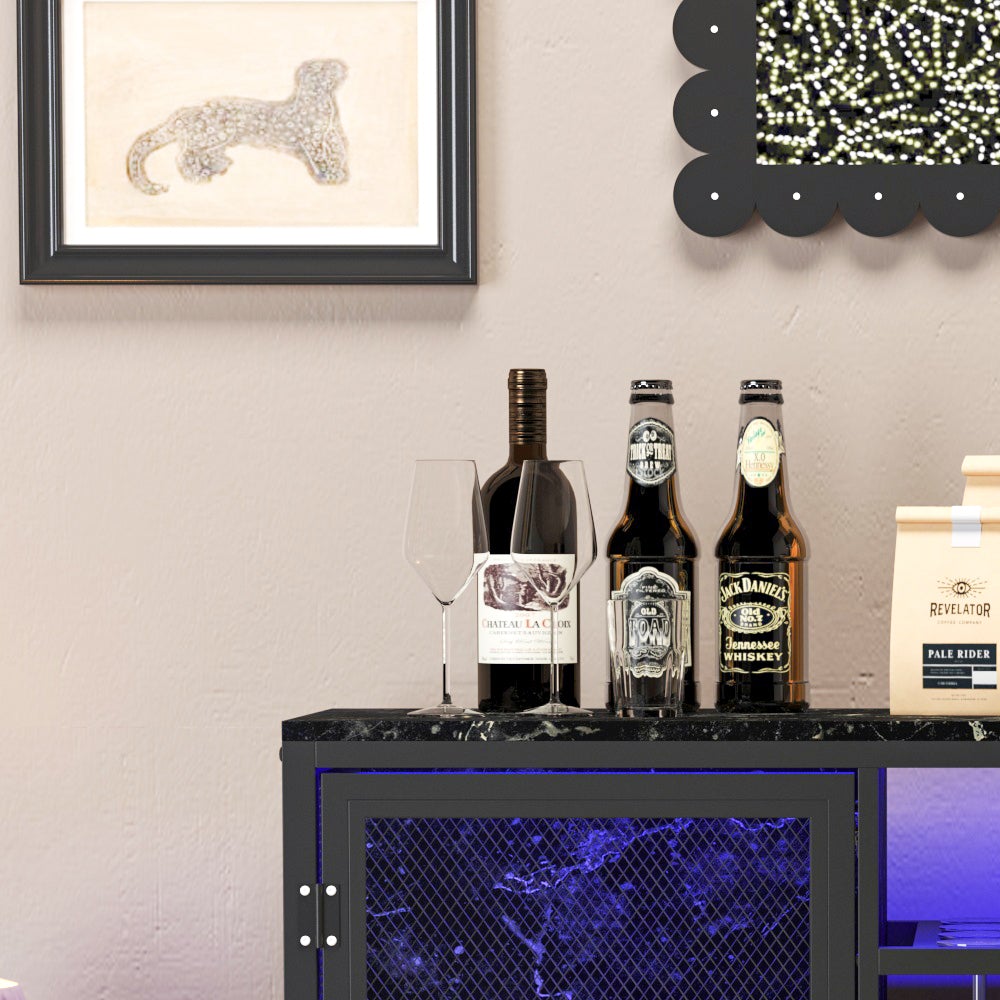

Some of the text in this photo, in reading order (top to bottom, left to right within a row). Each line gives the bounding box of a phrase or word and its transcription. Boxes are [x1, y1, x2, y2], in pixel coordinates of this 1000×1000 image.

[720, 577, 788, 602] JACK DANIEL'S
[640, 607, 657, 616] OLD
[740, 608, 761, 616] Old
[930, 602, 991, 618] REVELATOR
[525, 619, 539, 629] LA
[542, 619, 571, 629] COIX
[739, 615, 764, 623] No.7
[725, 636, 780, 650] Tennessee
[724, 652, 783, 661] WHISKEY
[928, 649, 991, 659] PALE RIDER
